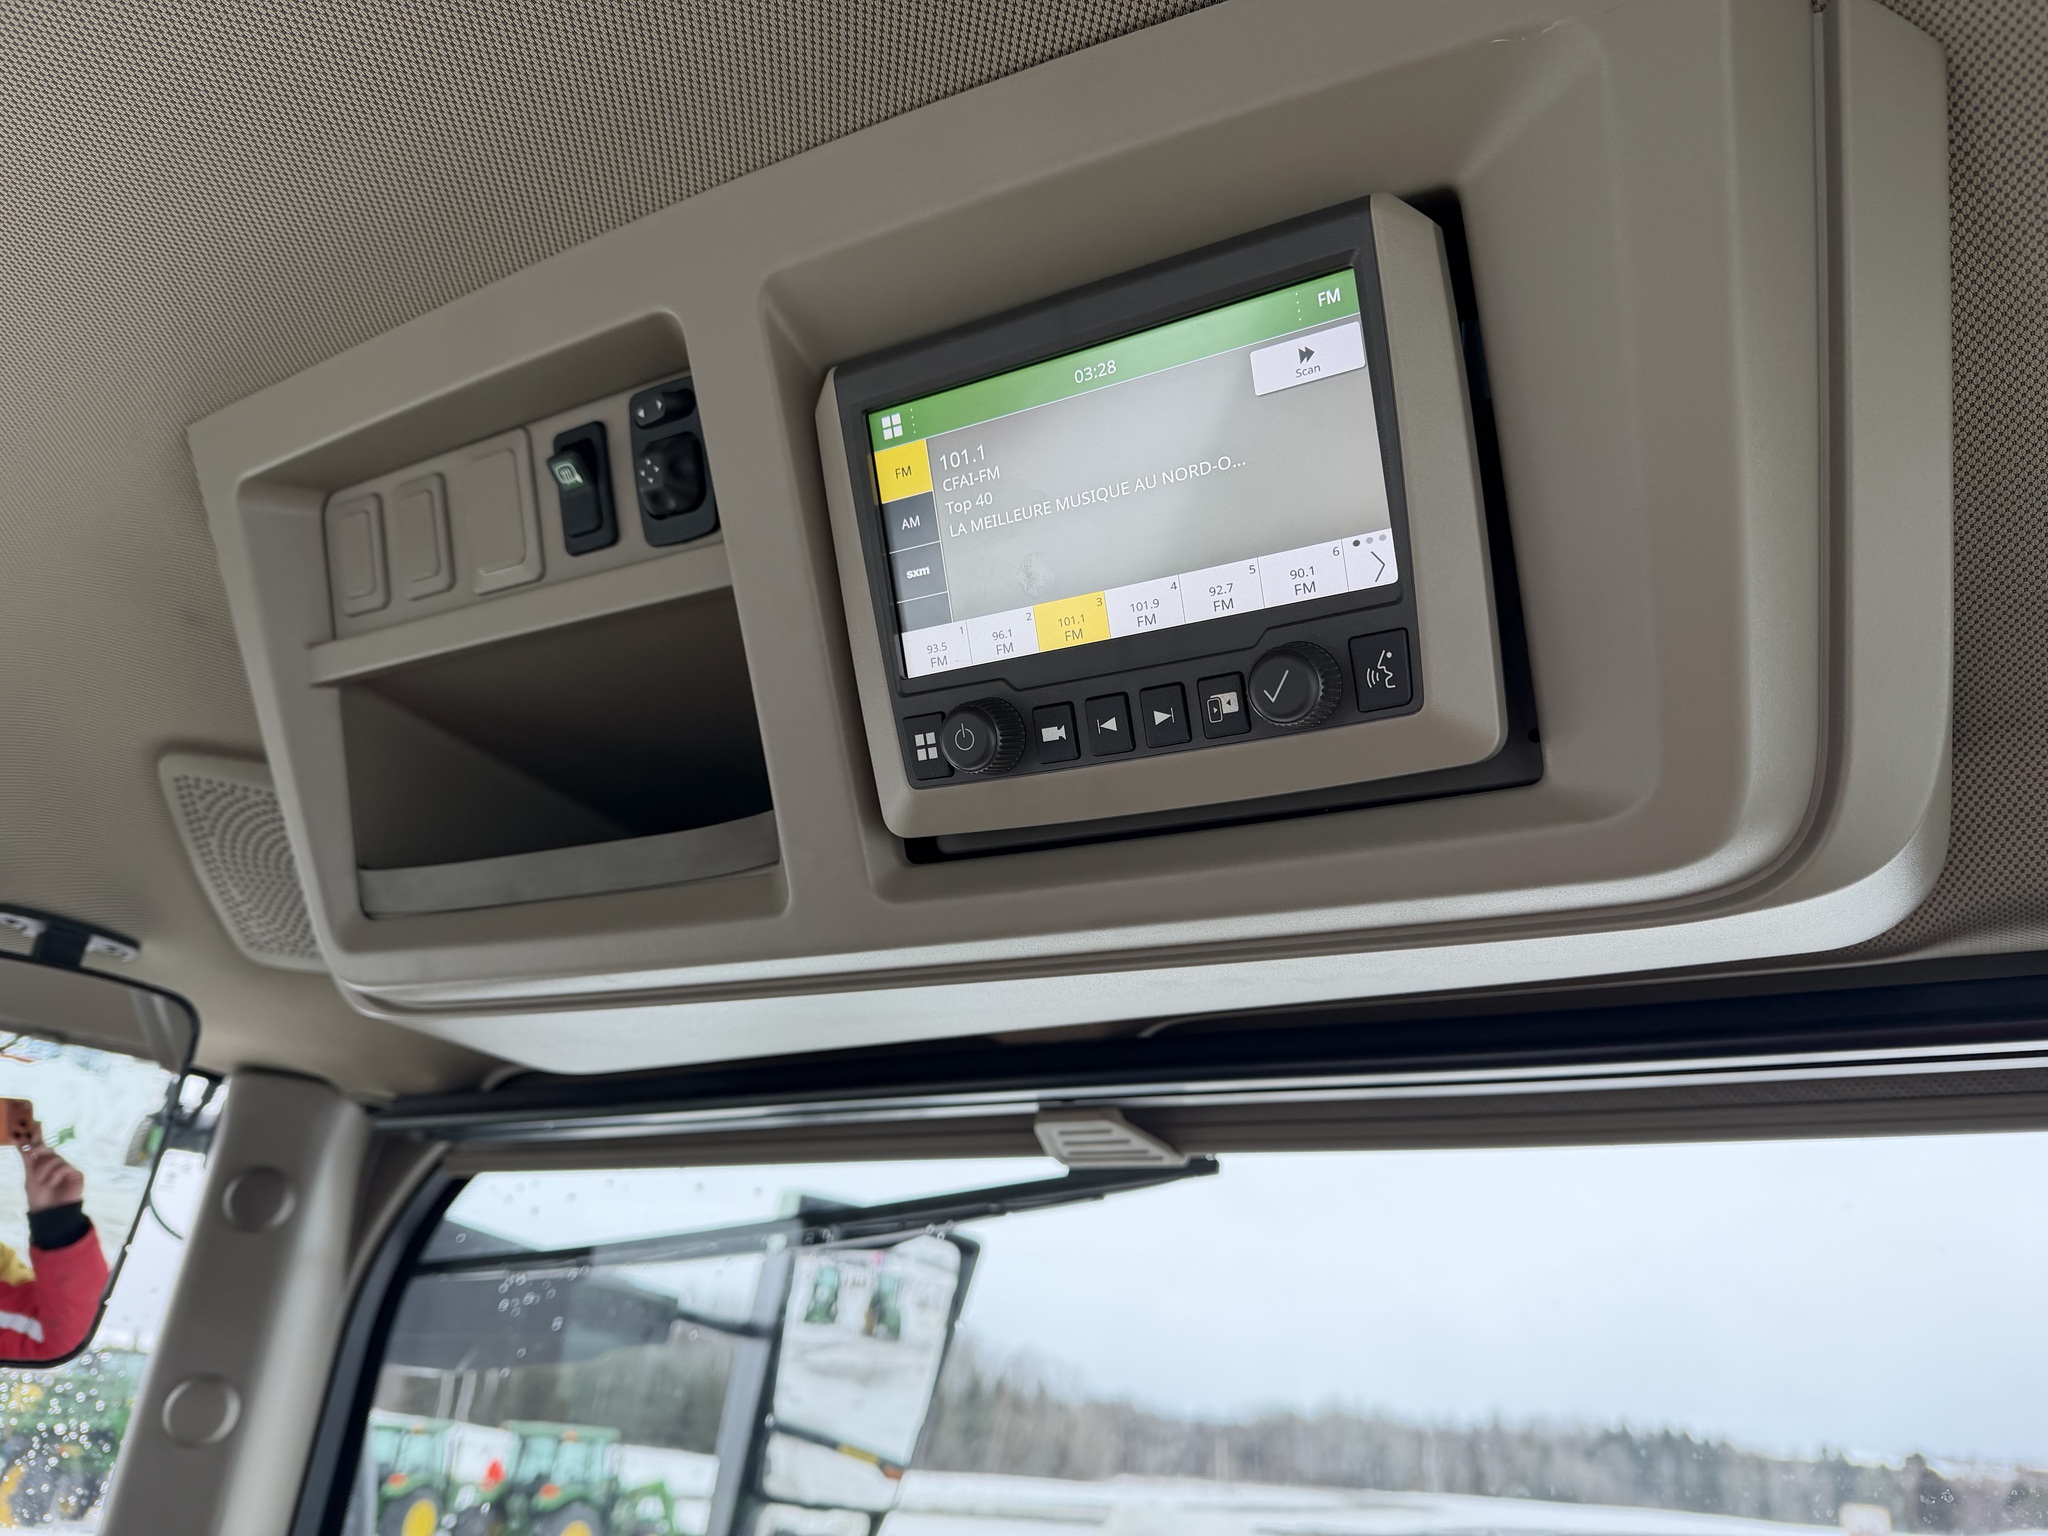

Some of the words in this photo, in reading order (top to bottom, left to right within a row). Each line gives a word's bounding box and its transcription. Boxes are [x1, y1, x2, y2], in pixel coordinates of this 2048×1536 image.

[1317, 287, 1341, 307] FM
[1074, 360, 1117, 384] 03:28
[1295, 364, 1321, 378] Scan
[939, 445, 986, 471] 101.1
[894, 465, 912, 480] FM
[942, 465, 1001, 492] CFAI-FM
[945, 498, 972, 516] Top
[975, 492, 993, 508] 40
[949, 521, 968, 537] LA
[970, 501, 1052, 533] MEILLEURE
[1055, 481, 1130, 512] MUSIQUE
[1134, 474, 1158, 491] AU
[901, 515, 921, 530] AM
[1332, 546, 1340, 557] 6
[1249, 565, 1256, 575] 5
[1289, 565, 1315, 580] 90.1
[1170, 581, 1178, 591] 4
[1208, 582, 1234, 597] 92.7
[1294, 581, 1316, 596] FM
[1096, 597, 1103, 607] 3
[1129, 598, 1160, 613] 101.9
[1213, 597, 1234, 612] FM
[1025, 612, 1033, 622] 2
[1057, 614, 1086, 628] 101.1
[1136, 613, 1157, 628] FM
[959, 626, 964, 635] 1
[992, 628, 1013, 641] 96.1
[1064, 628, 1084, 642] FM
[926, 642, 948, 654] 93.5
[996, 642, 1014, 655] FM
[930, 656, 948, 668] FM
